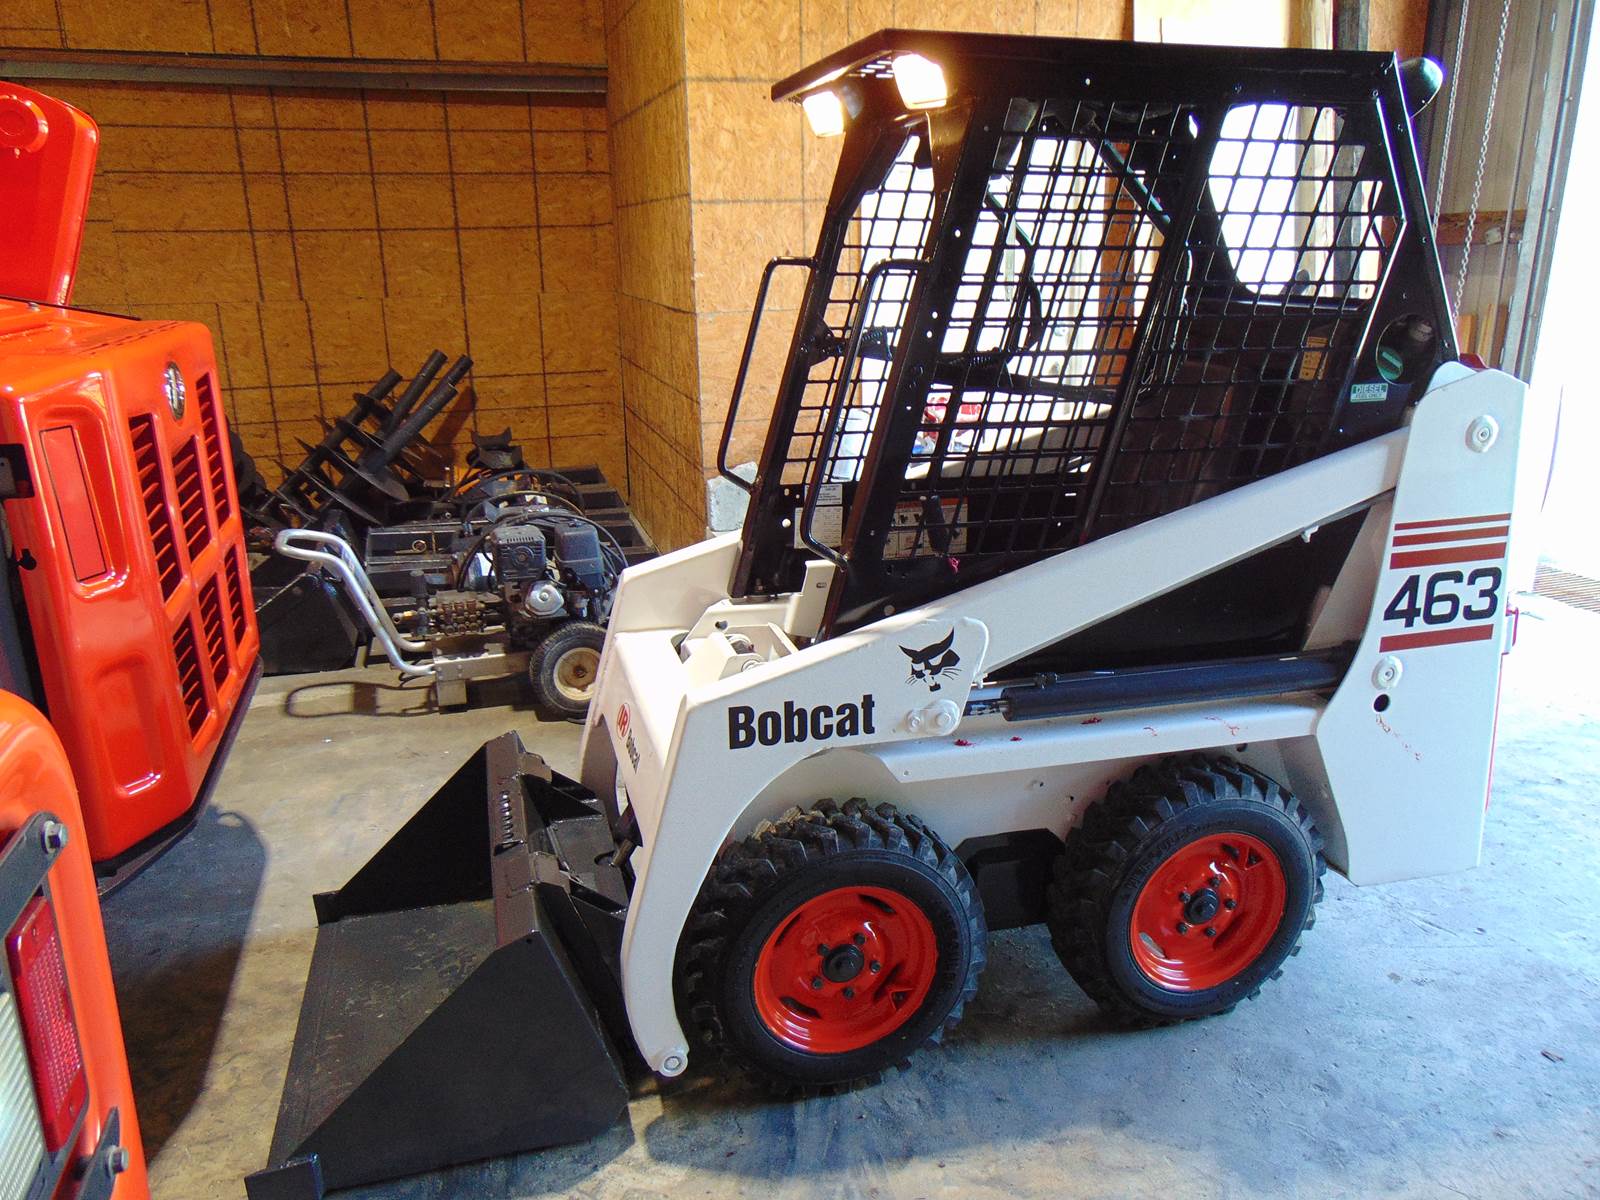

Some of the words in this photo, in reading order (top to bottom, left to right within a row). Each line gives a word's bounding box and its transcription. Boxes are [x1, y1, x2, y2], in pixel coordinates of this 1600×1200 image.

[1356, 384, 1383, 393] DIESEL
[1383, 567, 1502, 628] 463
[728, 694, 875, 749] Bobcat
[626, 727, 640, 775] Bobcat
